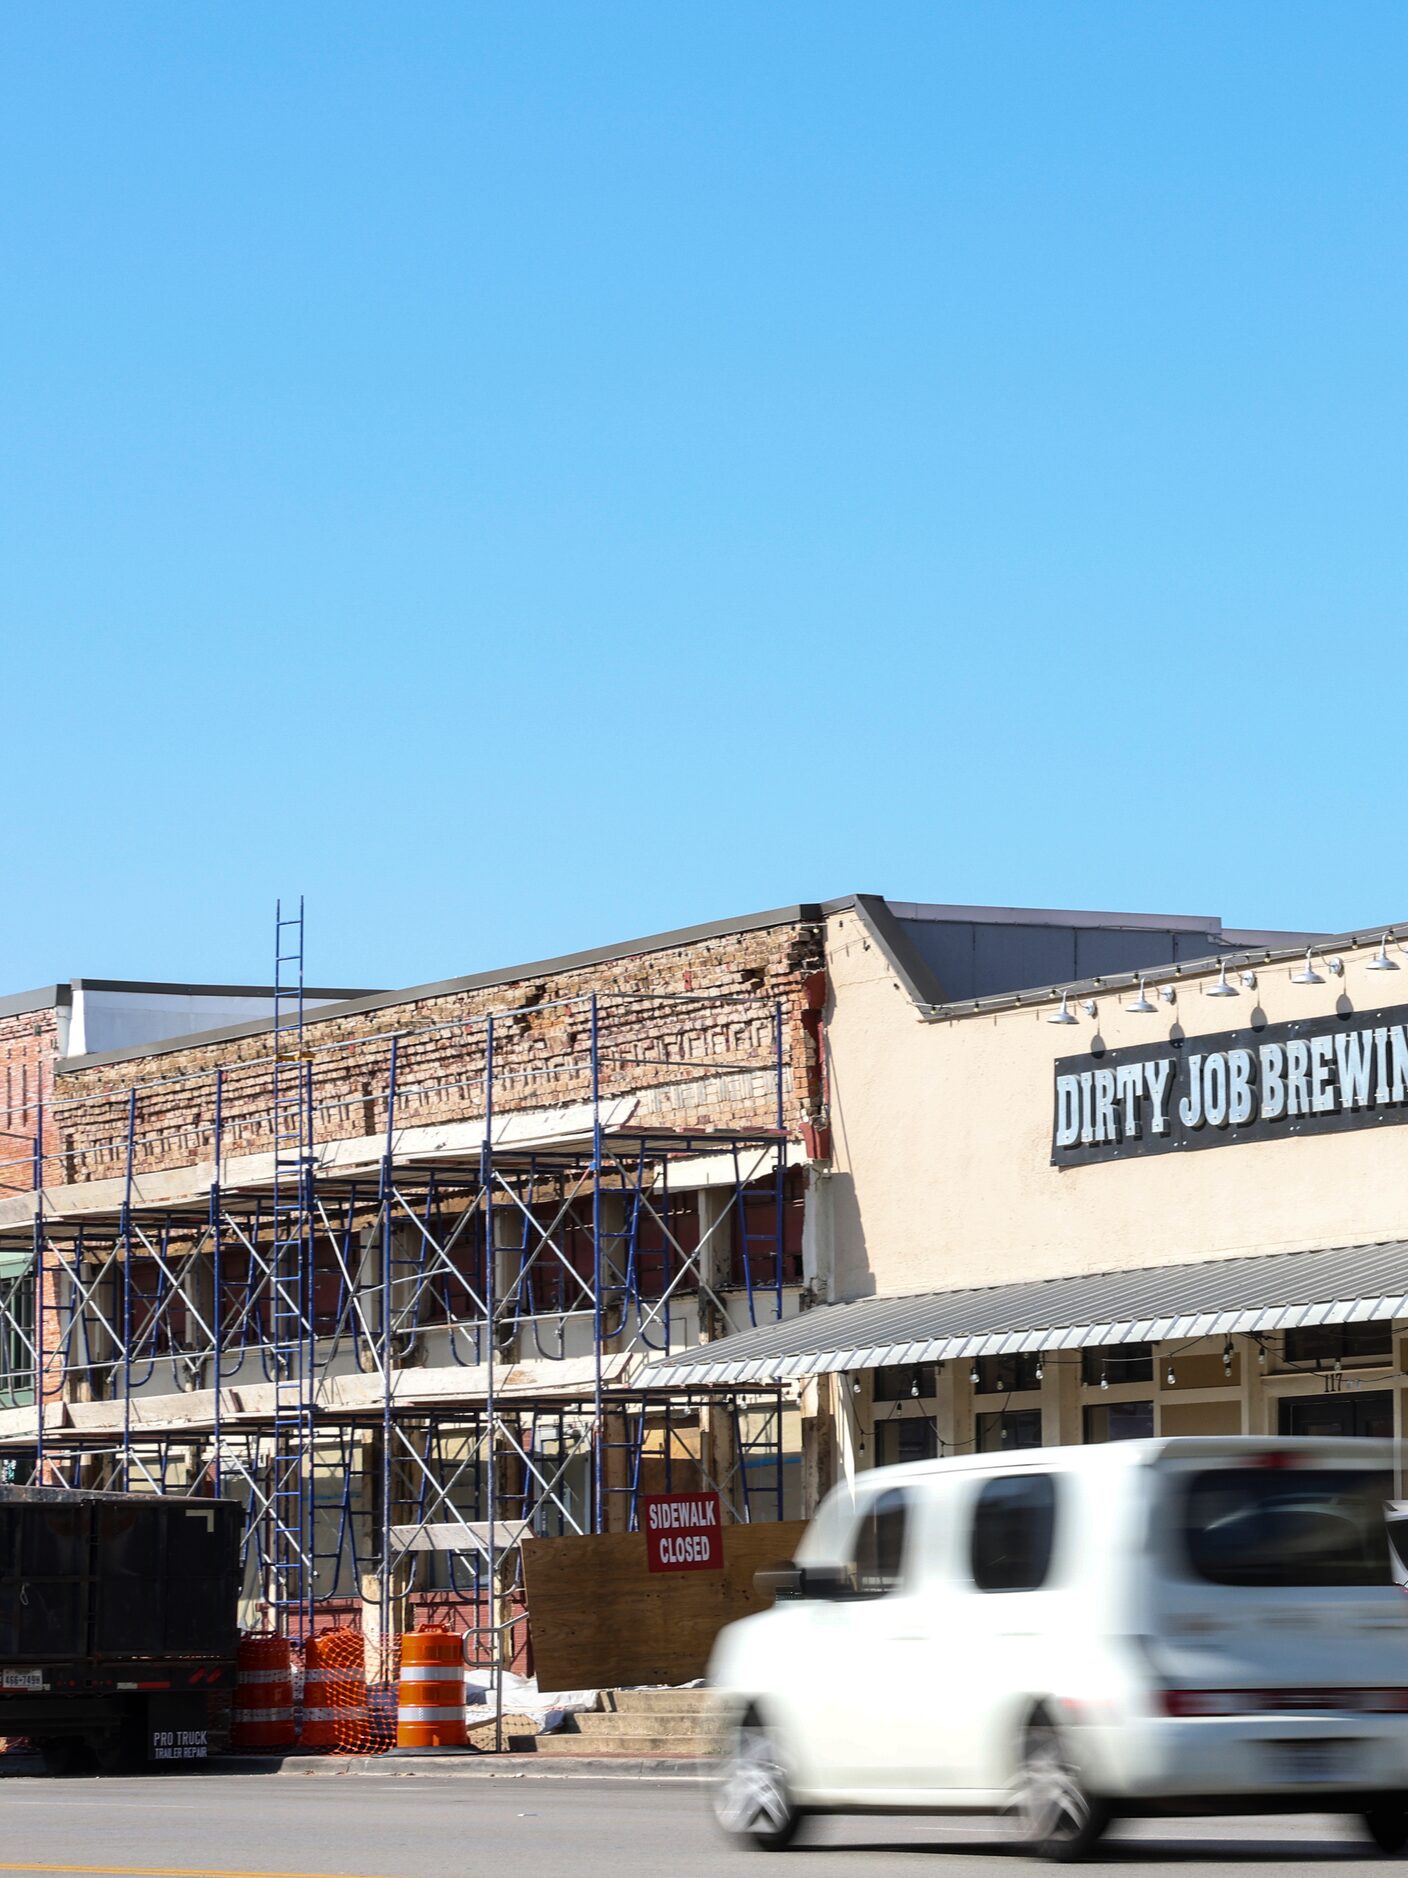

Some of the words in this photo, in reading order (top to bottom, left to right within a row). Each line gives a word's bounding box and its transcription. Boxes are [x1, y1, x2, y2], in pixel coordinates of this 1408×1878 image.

[1056, 1058, 1175, 1147] DIRTY
[1179, 1048, 1256, 1127] JOB
[1324, 1372, 1343, 1392] 117
[649, 1501, 716, 1529] SIDEWALK
[660, 1536, 709, 1563] CLOSED
[153, 1732, 173, 1746] PRO
[176, 1731, 208, 1745] TRUCK
[155, 1748, 182, 1759] TRAILER
[183, 1747, 208, 1758] REPAIR
